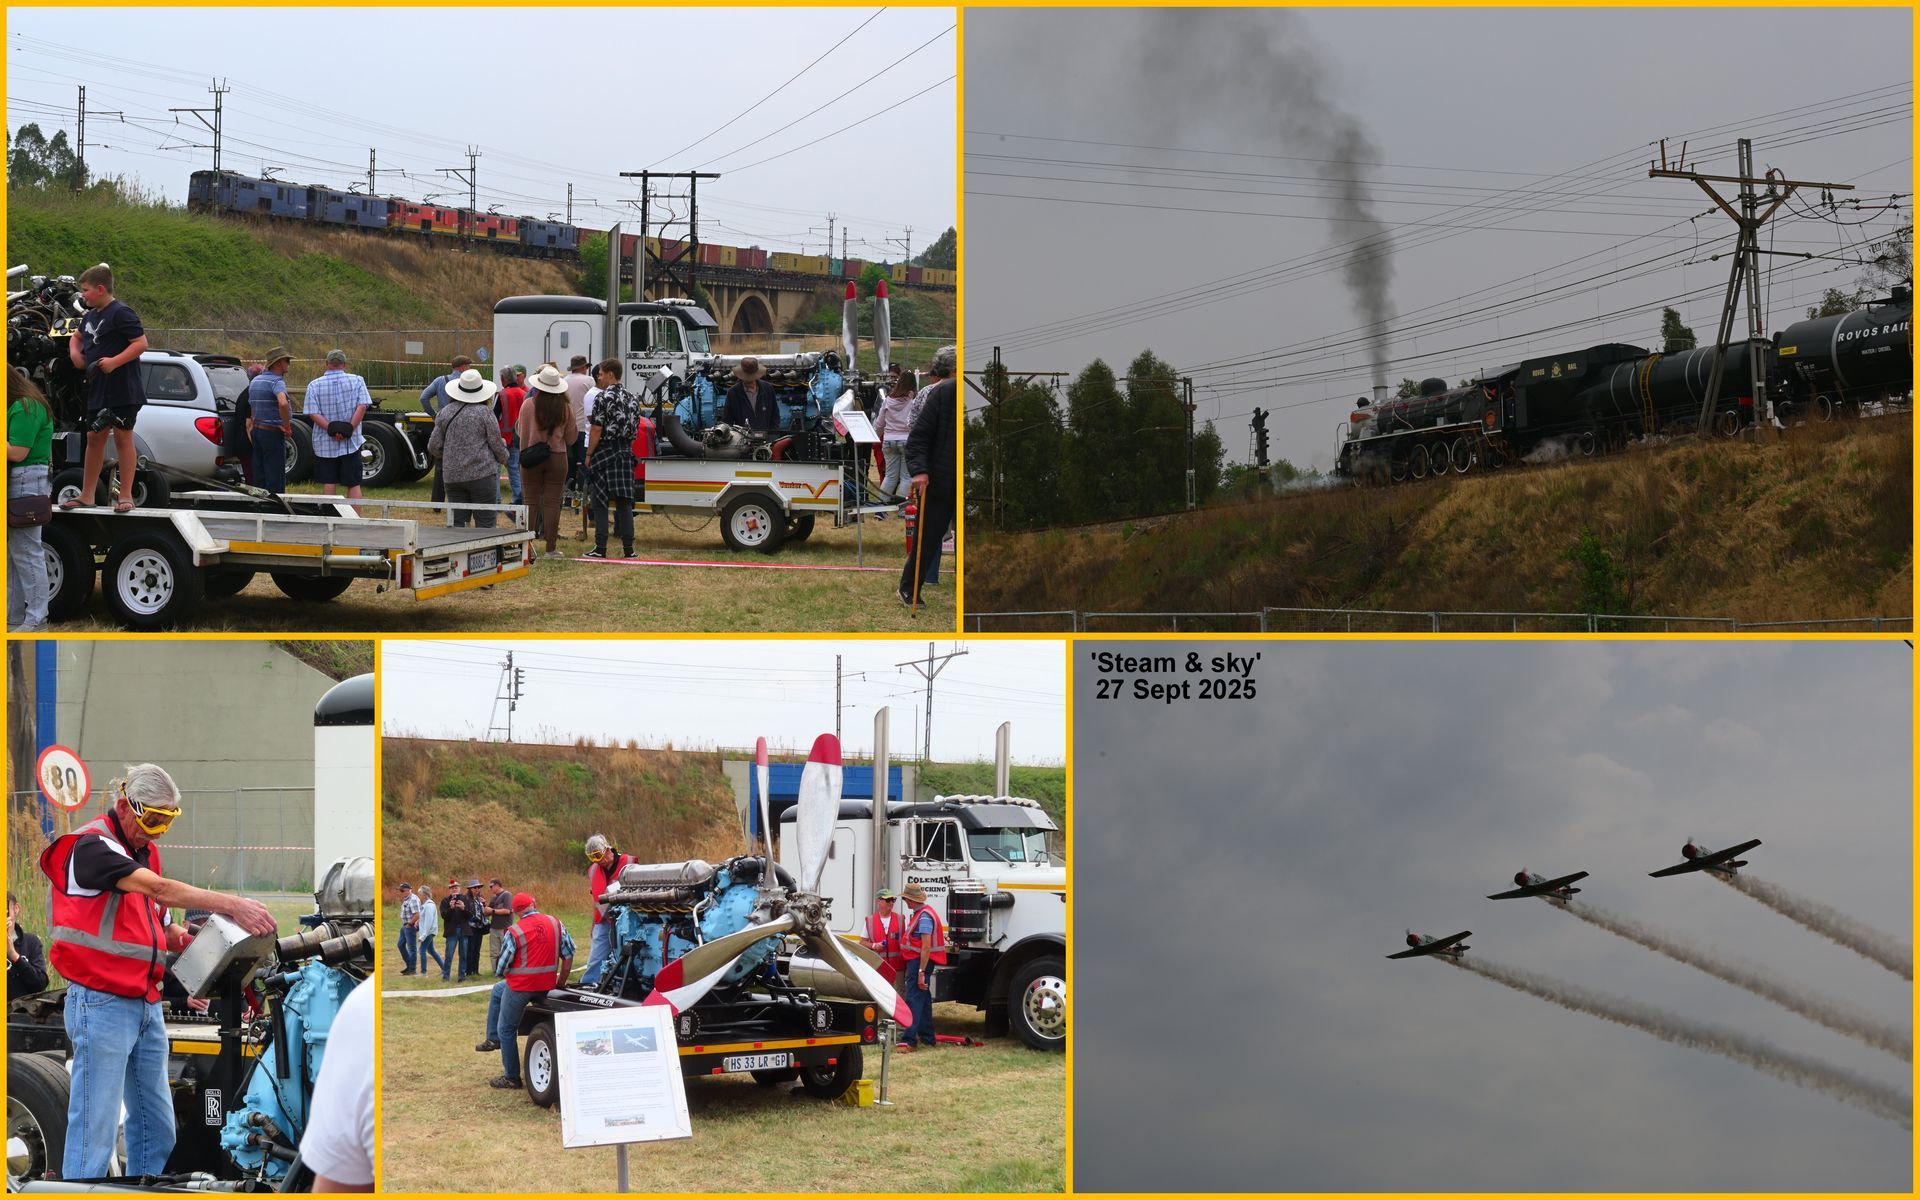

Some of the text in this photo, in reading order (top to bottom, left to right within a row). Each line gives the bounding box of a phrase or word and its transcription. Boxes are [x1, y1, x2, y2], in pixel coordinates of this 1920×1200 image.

[1837, 321, 1910, 342] ROVOS RAIL
[631, 362, 672, 371] COLEMN
[907, 875, 951, 884] COLEMAN
[731, 1054, 786, 1070] HS 33 LR GP
